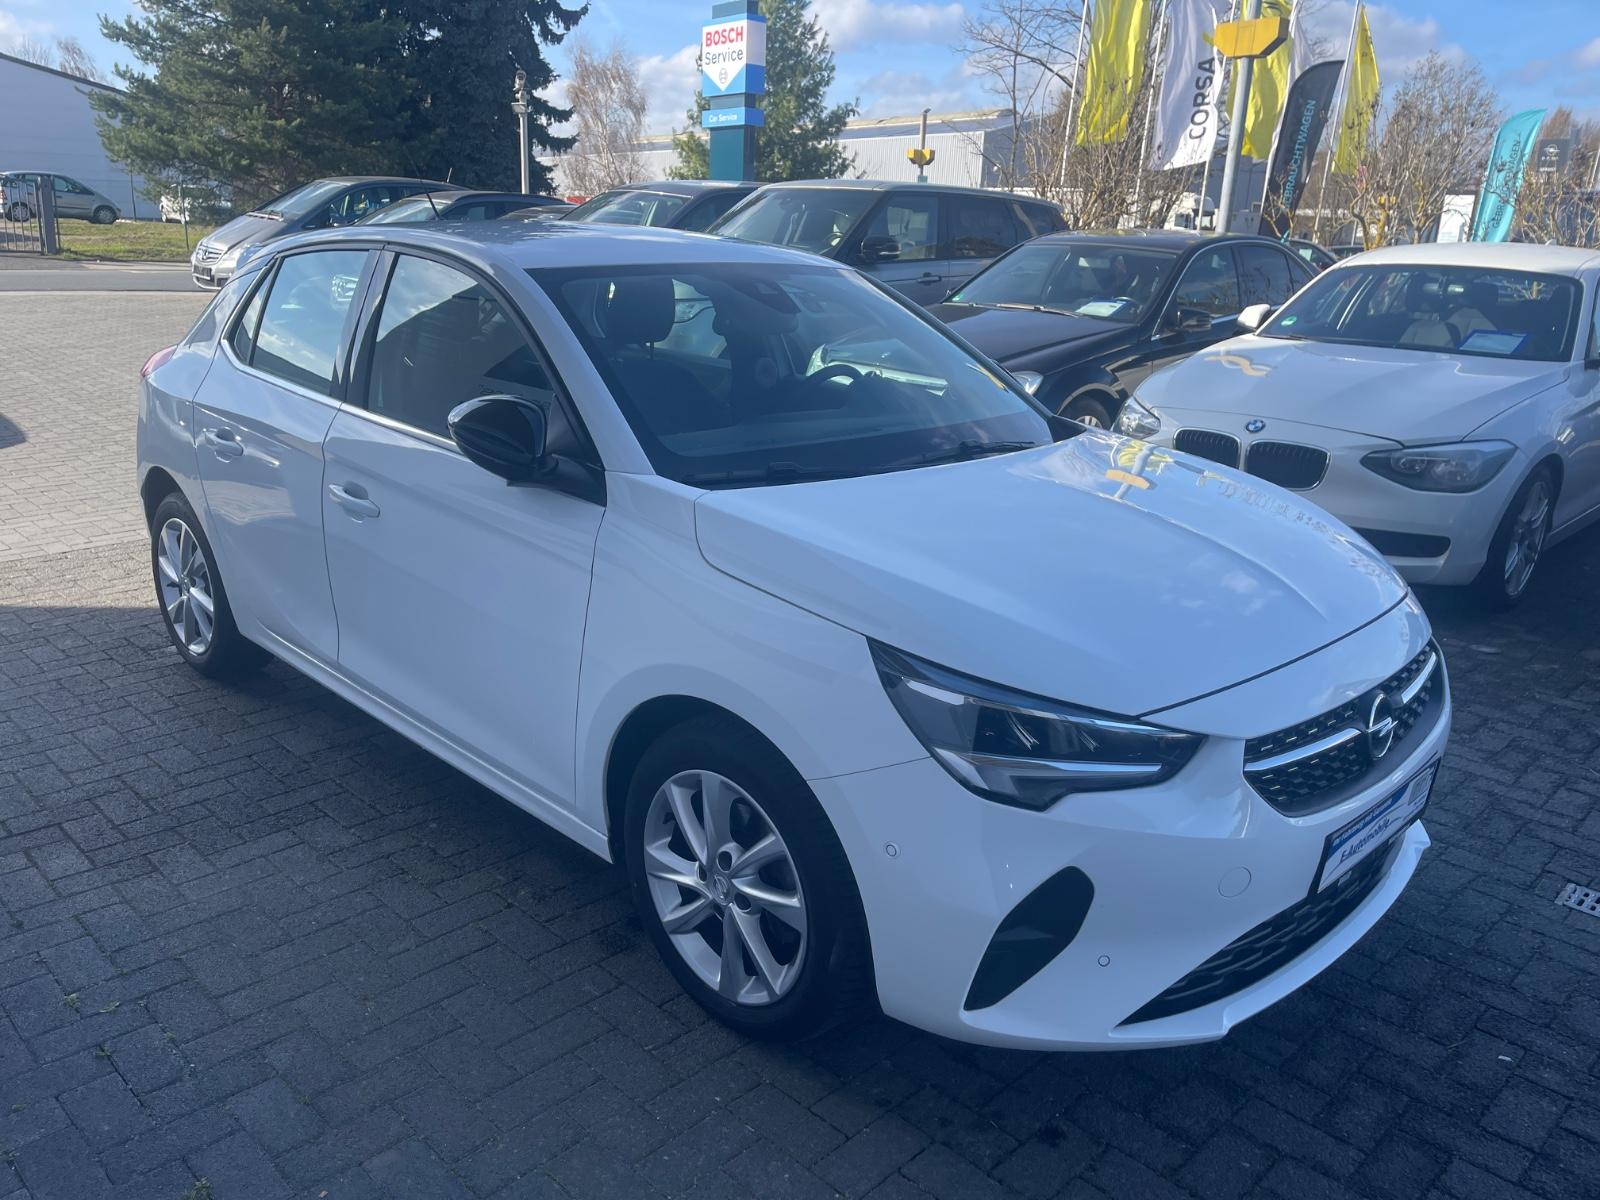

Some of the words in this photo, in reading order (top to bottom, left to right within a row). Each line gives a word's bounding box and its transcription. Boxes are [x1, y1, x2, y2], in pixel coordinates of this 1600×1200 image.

[705, 26, 744, 47] BOSCH
[705, 48, 743, 65] Service
[1188, 56, 1215, 140] CORSA
[709, 114, 717, 123] Car
[719, 113, 737, 121] Service
[1491, 138, 1521, 229] GEBRUCWAGEN
